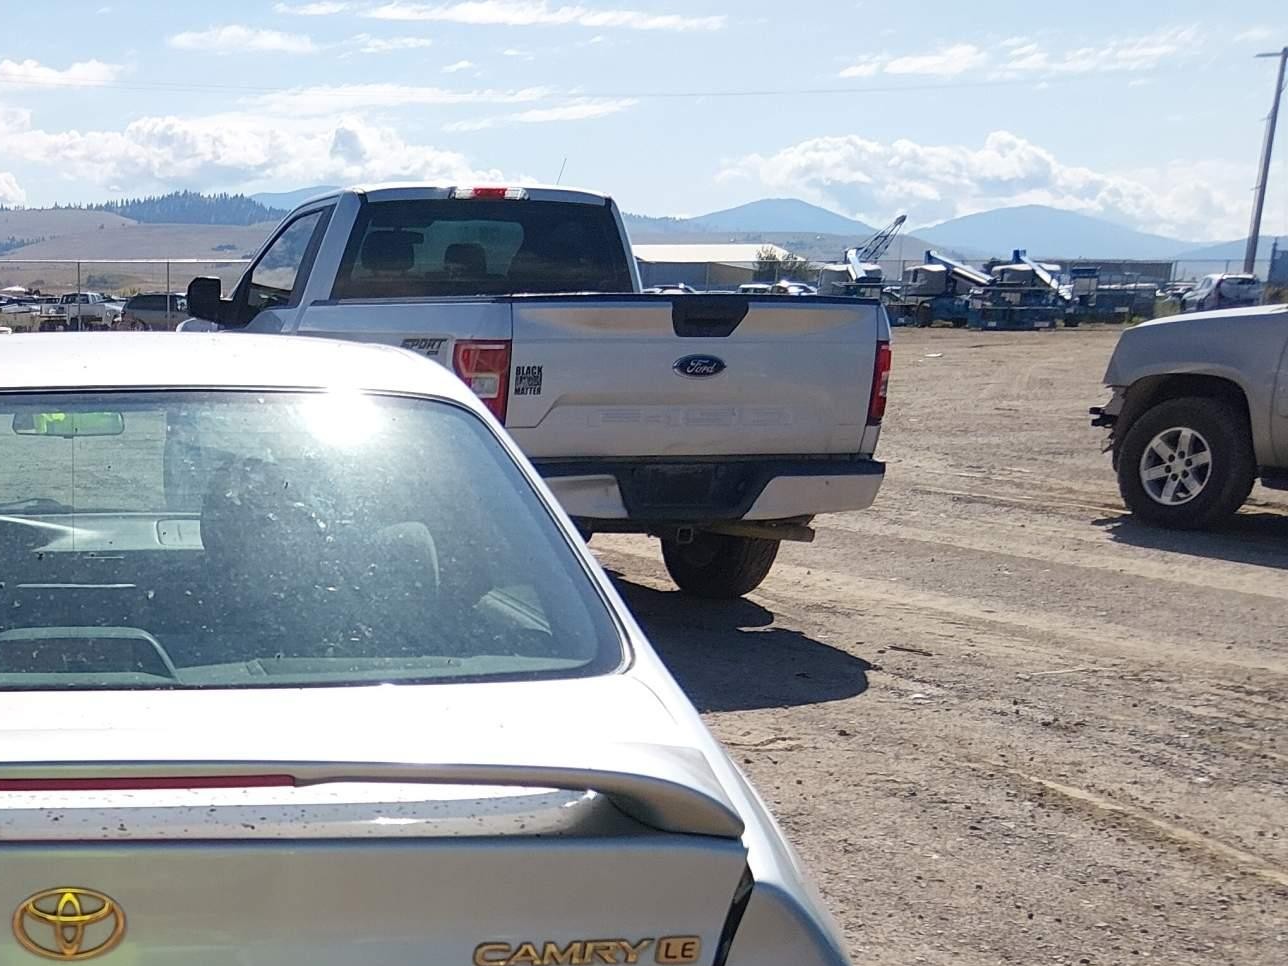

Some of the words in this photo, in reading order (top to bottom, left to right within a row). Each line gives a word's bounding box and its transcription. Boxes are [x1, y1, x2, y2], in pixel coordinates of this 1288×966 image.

[400, 338, 448, 351] SPORT
[516, 366, 543, 376] BLACK
[686, 359, 718, 374] Ford
[514, 386, 541, 395] MATTER
[664, 942, 696, 959] LE
